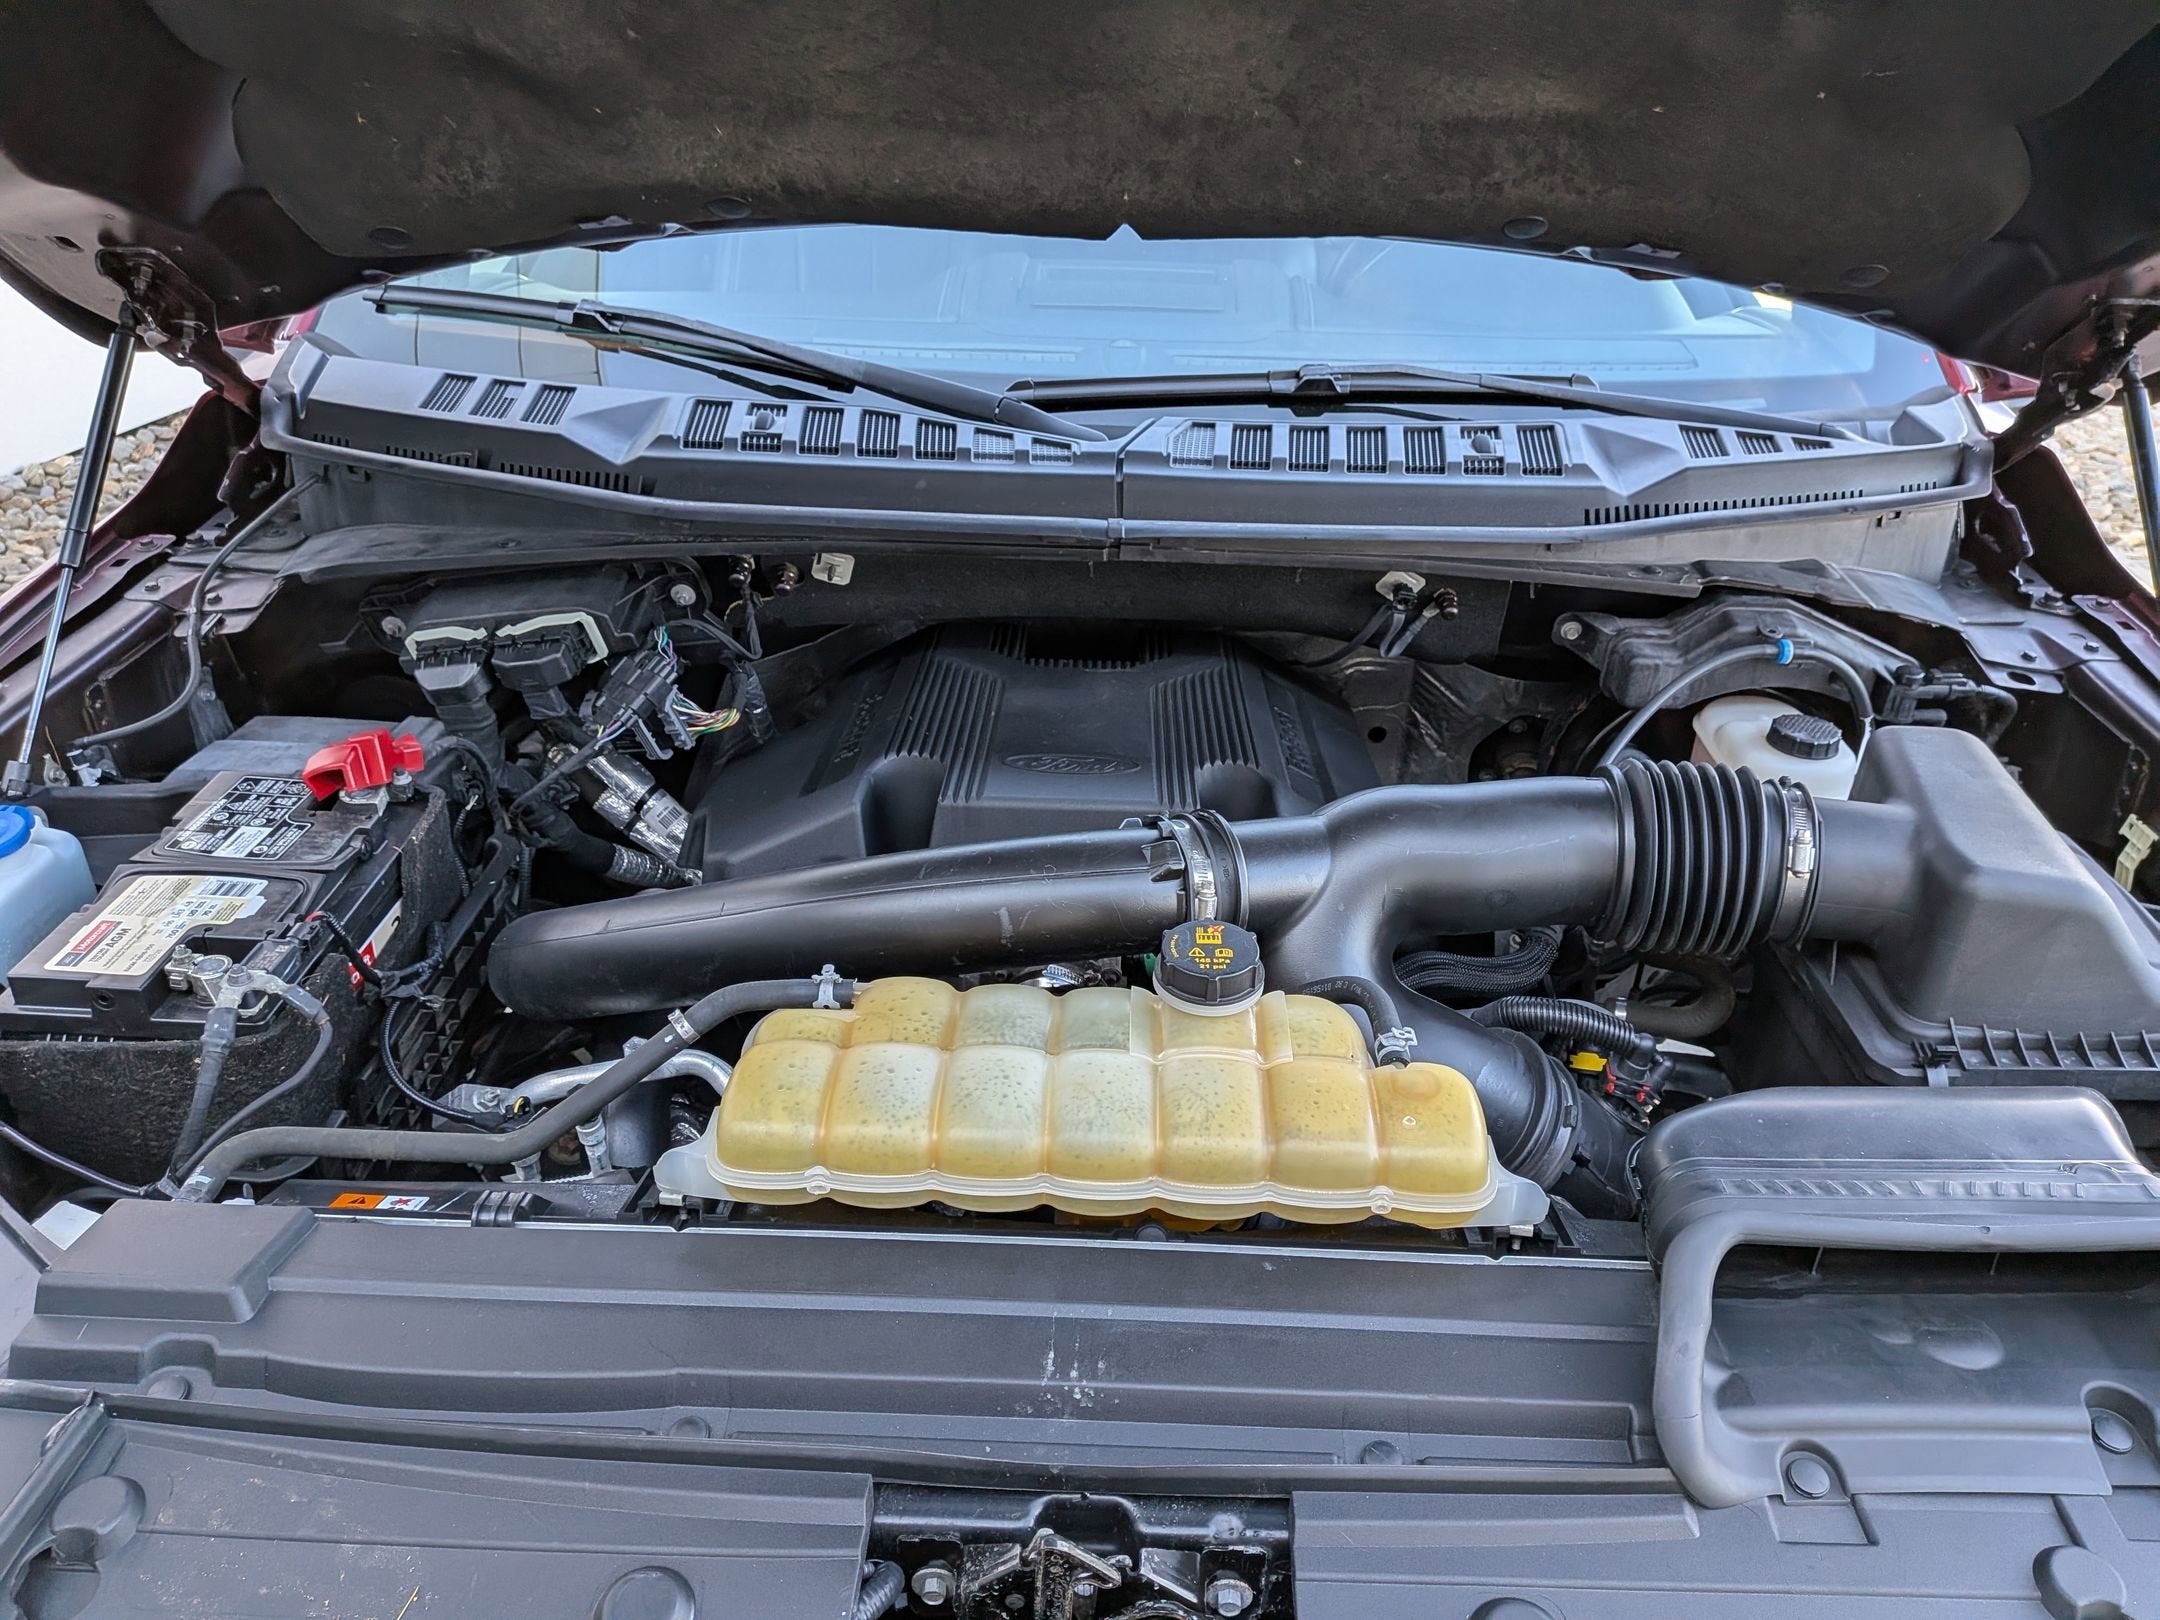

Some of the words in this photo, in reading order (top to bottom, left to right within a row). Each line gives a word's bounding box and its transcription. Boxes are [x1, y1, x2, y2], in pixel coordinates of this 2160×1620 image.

[1028, 755, 1120, 774] Ford
[77, 921, 112, 952] Motorcraft
[107, 927, 132, 949] AGM
